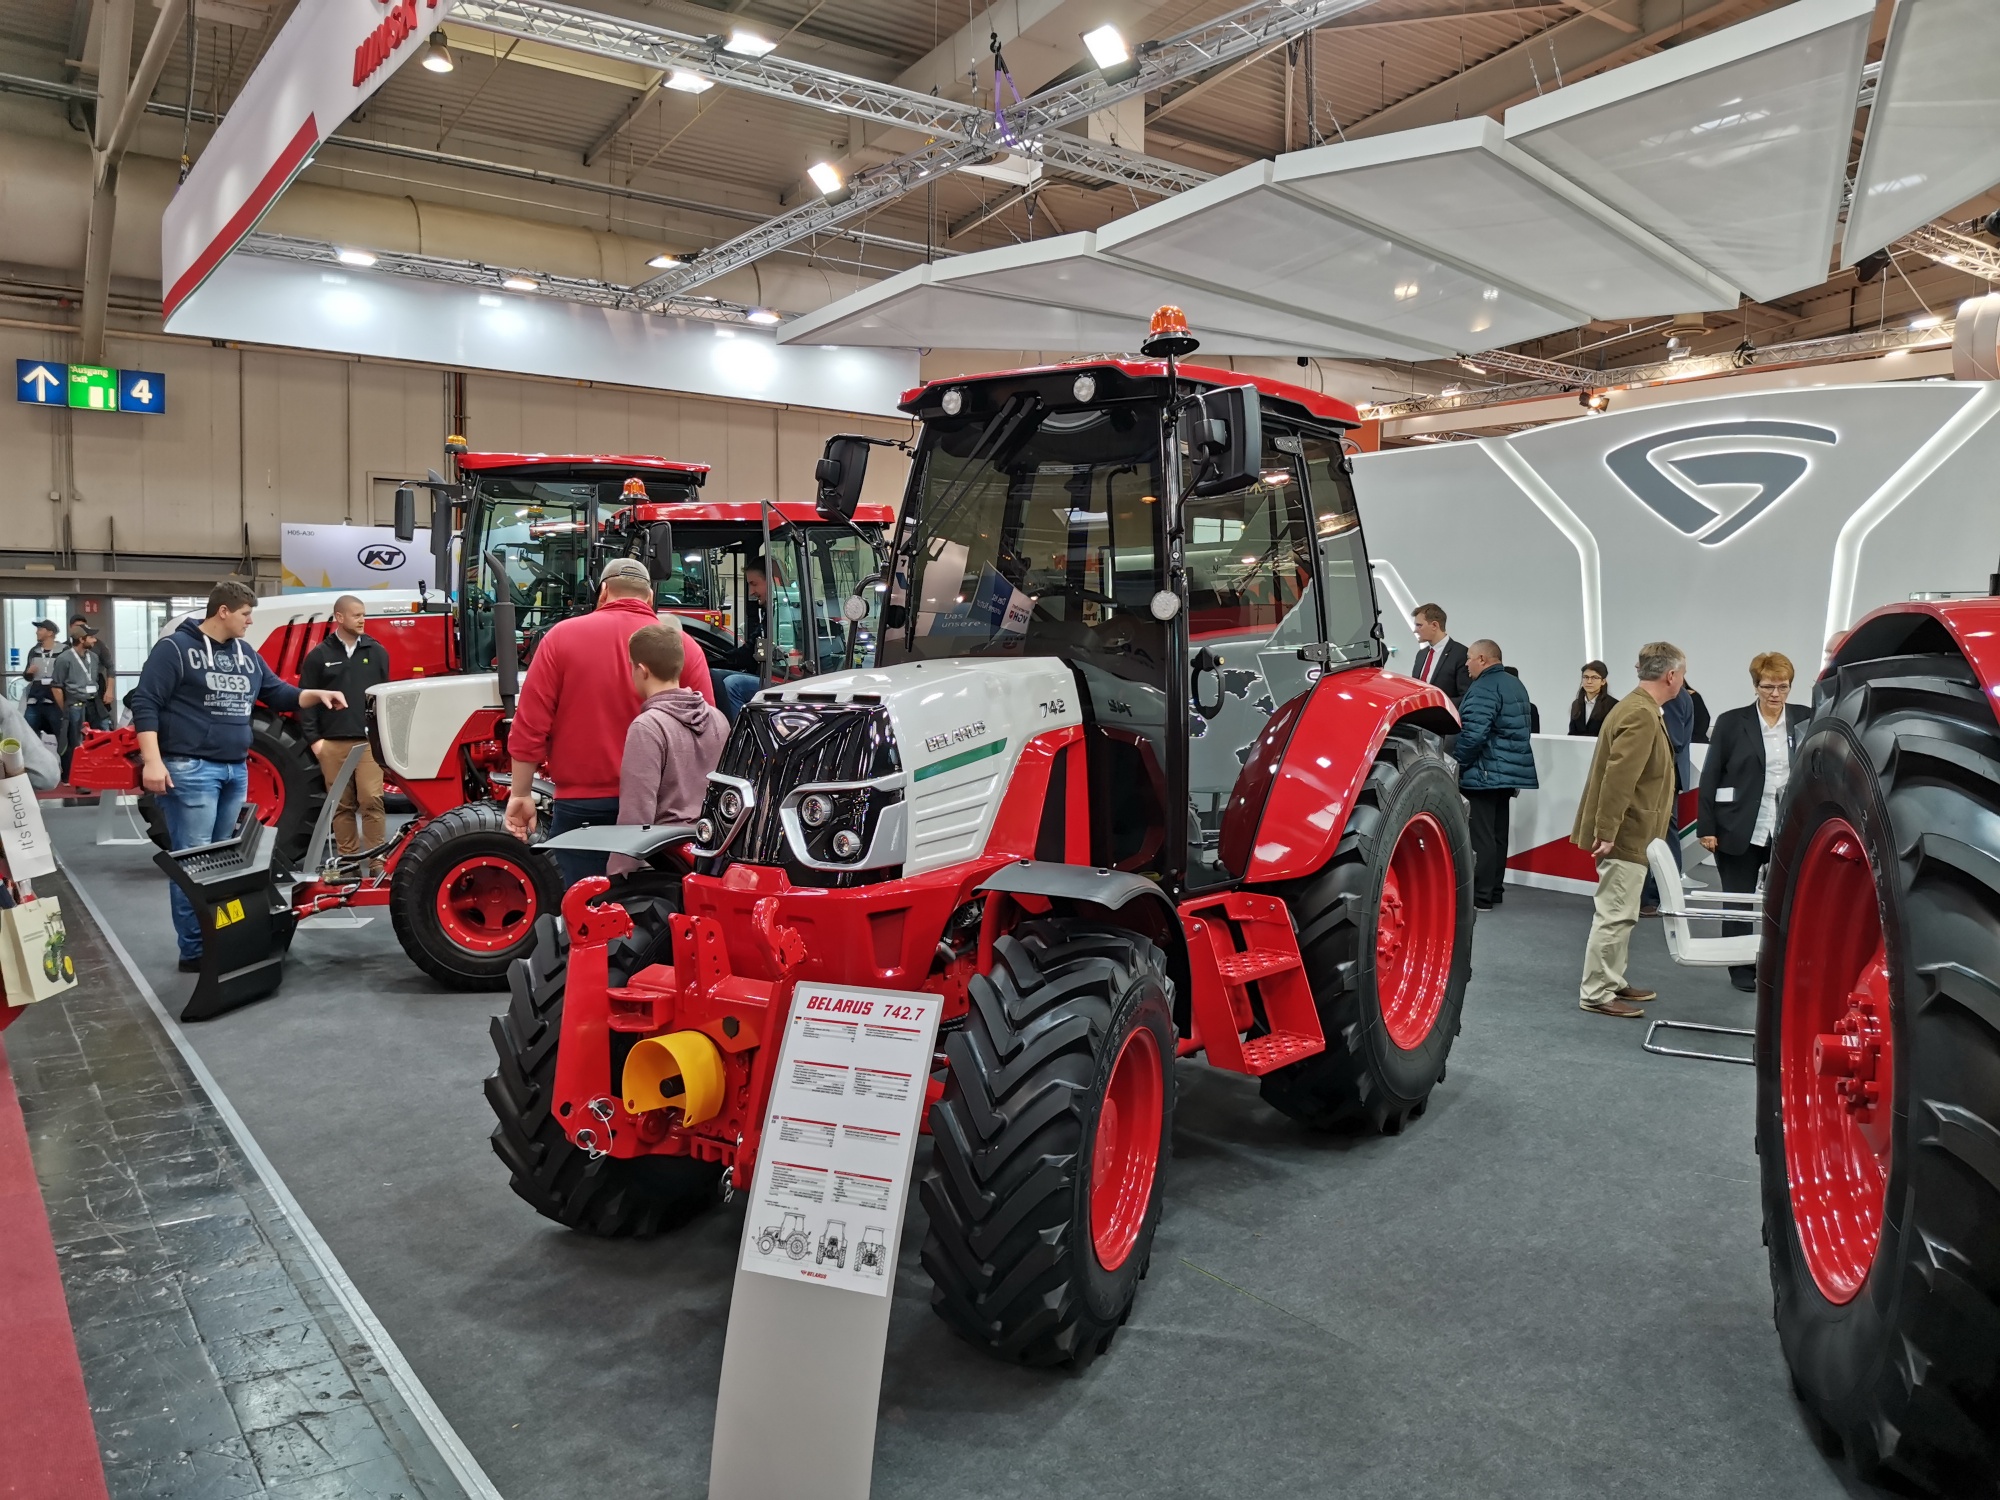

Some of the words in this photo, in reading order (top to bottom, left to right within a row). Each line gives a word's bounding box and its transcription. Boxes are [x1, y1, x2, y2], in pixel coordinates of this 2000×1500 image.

[71, 366, 108, 378] Ausgang
[71, 375, 88, 384] Exit
[131, 379, 153, 404] 4
[211, 674, 247, 691] 1963
[1039, 699, 1066, 718] 742
[925, 720, 987, 752] BELARUS
[17, 830, 35, 851] It's
[806, 995, 873, 1015] BELARUS
[882, 1004, 925, 1021] 742.7
